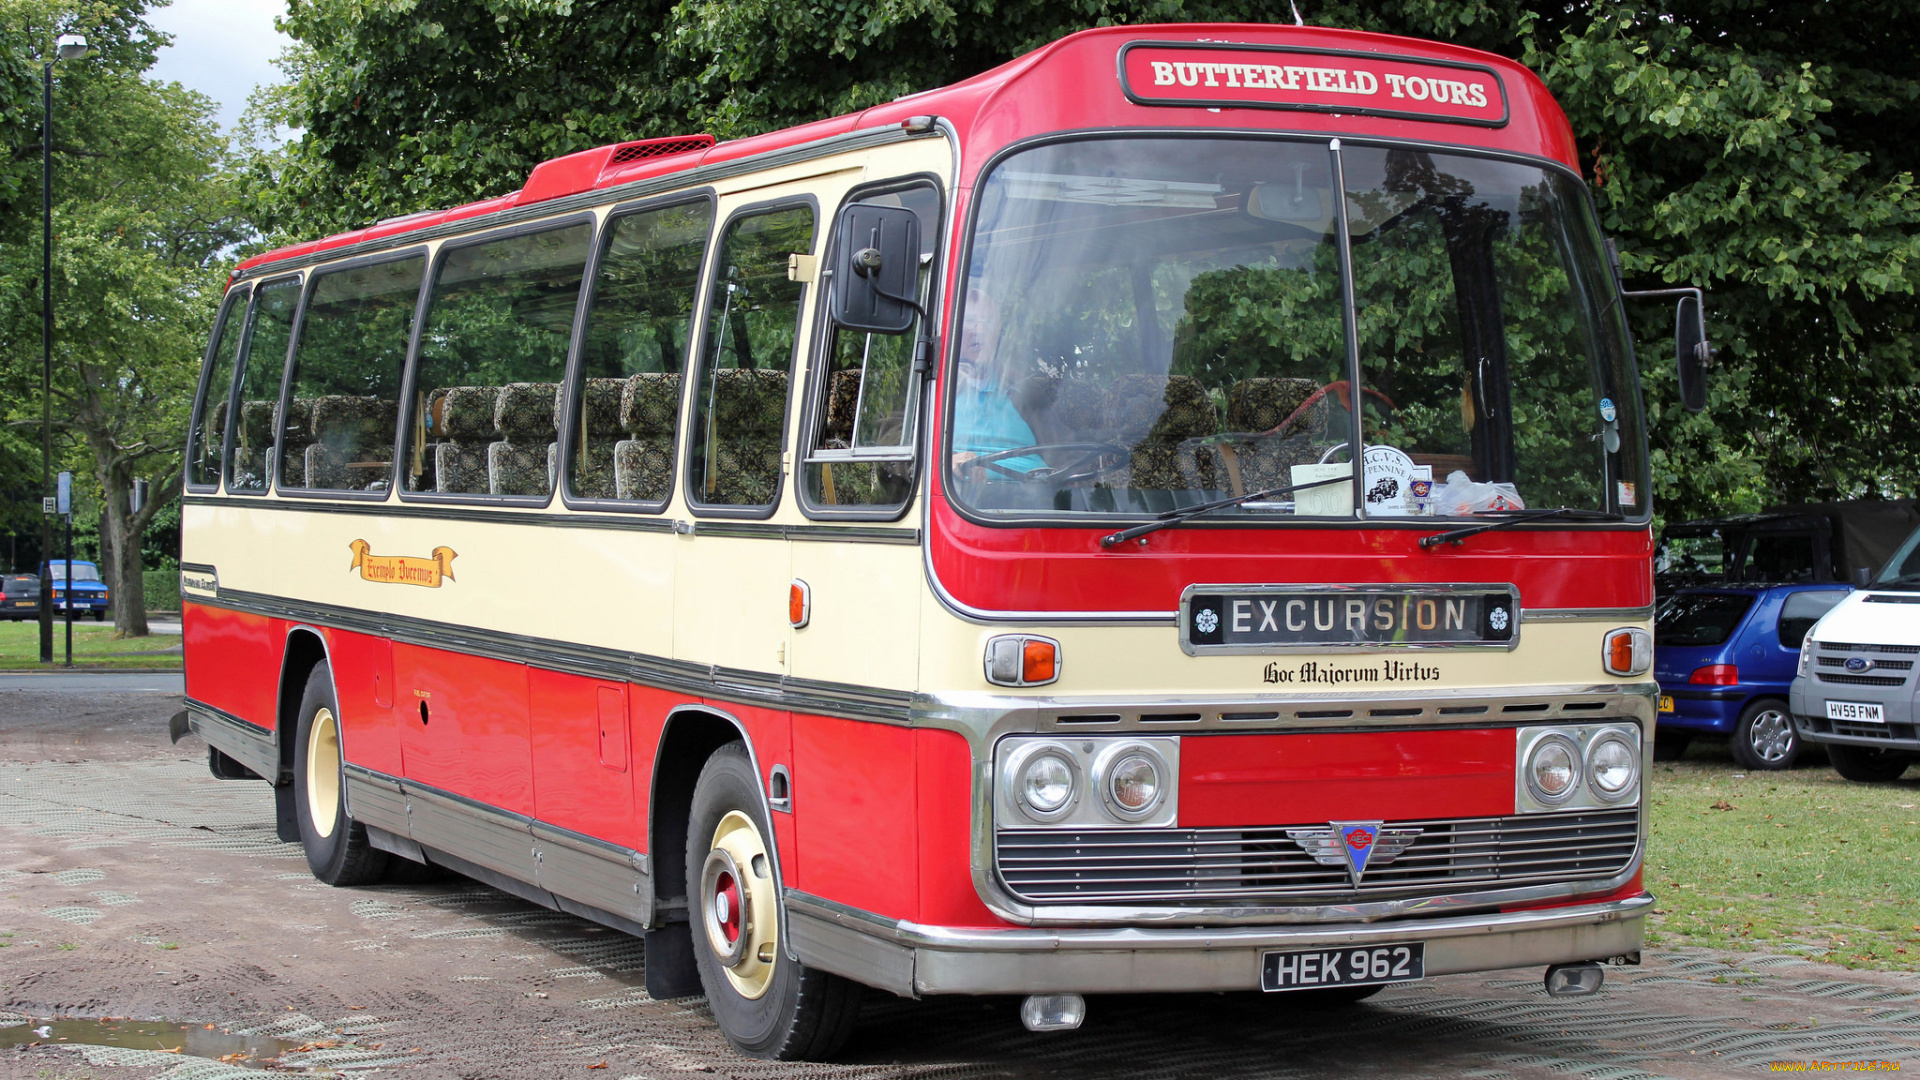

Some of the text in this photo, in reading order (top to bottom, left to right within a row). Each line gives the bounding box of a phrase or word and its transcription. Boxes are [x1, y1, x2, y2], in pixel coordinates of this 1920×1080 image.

[1151, 61, 1487, 108] BUTTERFIELD TOURS
[367, 558, 396, 581] Exemplo
[1232, 599, 1466, 633] EXCURSION
[1263, 660, 1440, 687] Hoc Majorum Virtus
[1830, 703, 1879, 719] HV59 FNM
[1350, 835, 1371, 844] AEC
[1278, 947, 1411, 985] HEK 962
